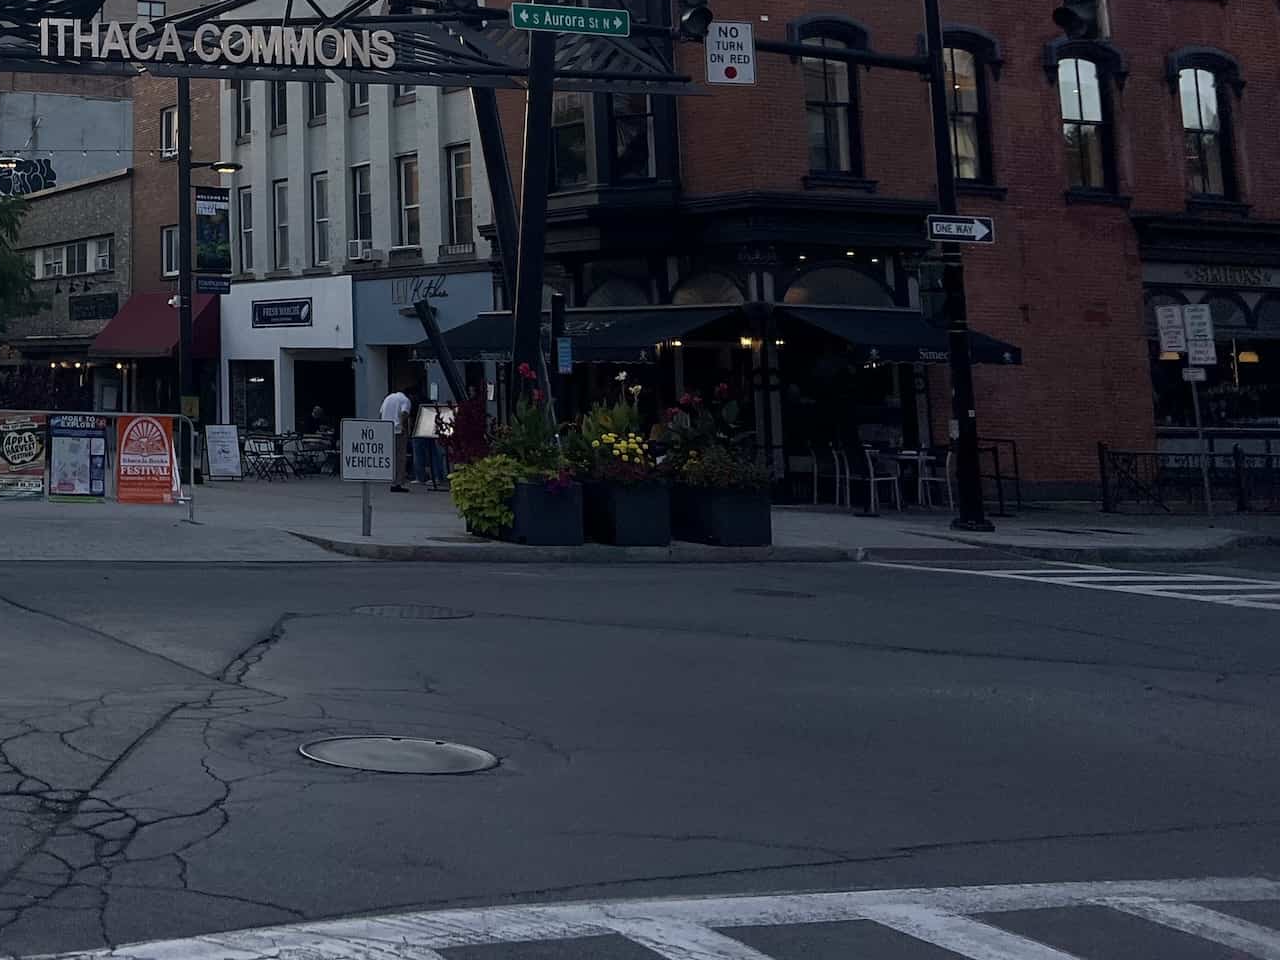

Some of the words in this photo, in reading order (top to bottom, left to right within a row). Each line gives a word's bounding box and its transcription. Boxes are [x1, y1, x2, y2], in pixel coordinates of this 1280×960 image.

[532, 13, 540, 25] S
[544, 10, 585, 28] Aurora
[589, 17, 598, 29] St
[603, 18, 610, 30] N
[719, 26, 739, 38] NO
[40, 17, 185, 62] ITHACA
[193, 24, 396, 69] COMMONS
[715, 41, 743, 51] TURN
[710, 53, 724, 63] ON
[730, 55, 750, 64] RED
[935, 223, 953, 233] ONE
[955, 224, 973, 234] WAY
[6, 434, 34, 445] APPLE
[361, 428, 375, 440] NO
[5, 442, 35, 456] HARVEST
[352, 442, 384, 454] MOTOR
[345, 455, 391, 468] VEHICLES
[120, 466, 170, 475] FESTIVAL
